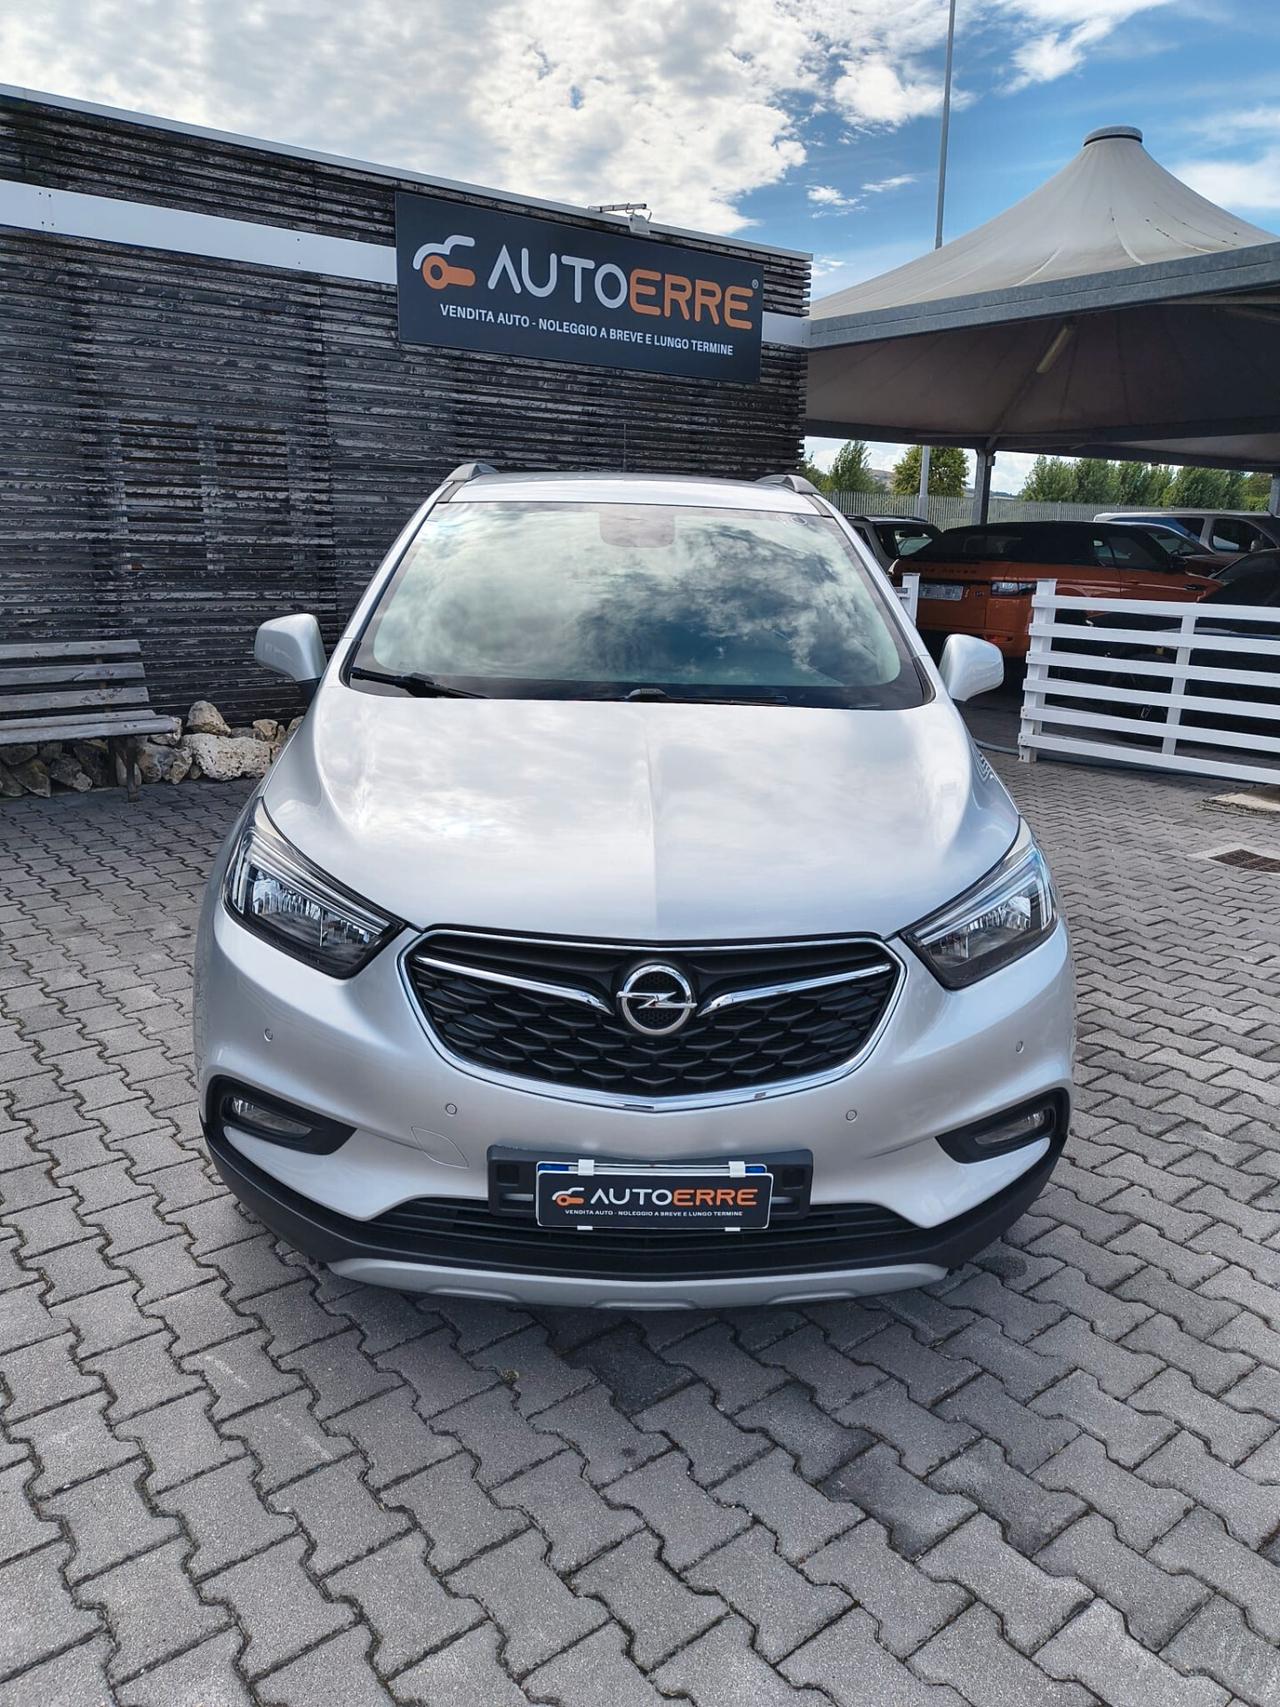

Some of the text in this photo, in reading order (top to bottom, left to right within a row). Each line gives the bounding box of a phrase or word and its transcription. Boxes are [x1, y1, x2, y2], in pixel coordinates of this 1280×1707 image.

[487, 243, 754, 330] AUTOERRE
[440, 303, 495, 323] VENDITA
[497, 312, 530, 327] AUTO
[539, 317, 598, 337] NOLEGGIO
[600, 327, 608, 339] A
[609, 328, 644, 344] BREVE
[645, 333, 652, 345] E
[654, 335, 690, 350] LUNGO
[691, 339, 734, 356] TERMINE
[590, 1187, 758, 1206] AUTOERRE
